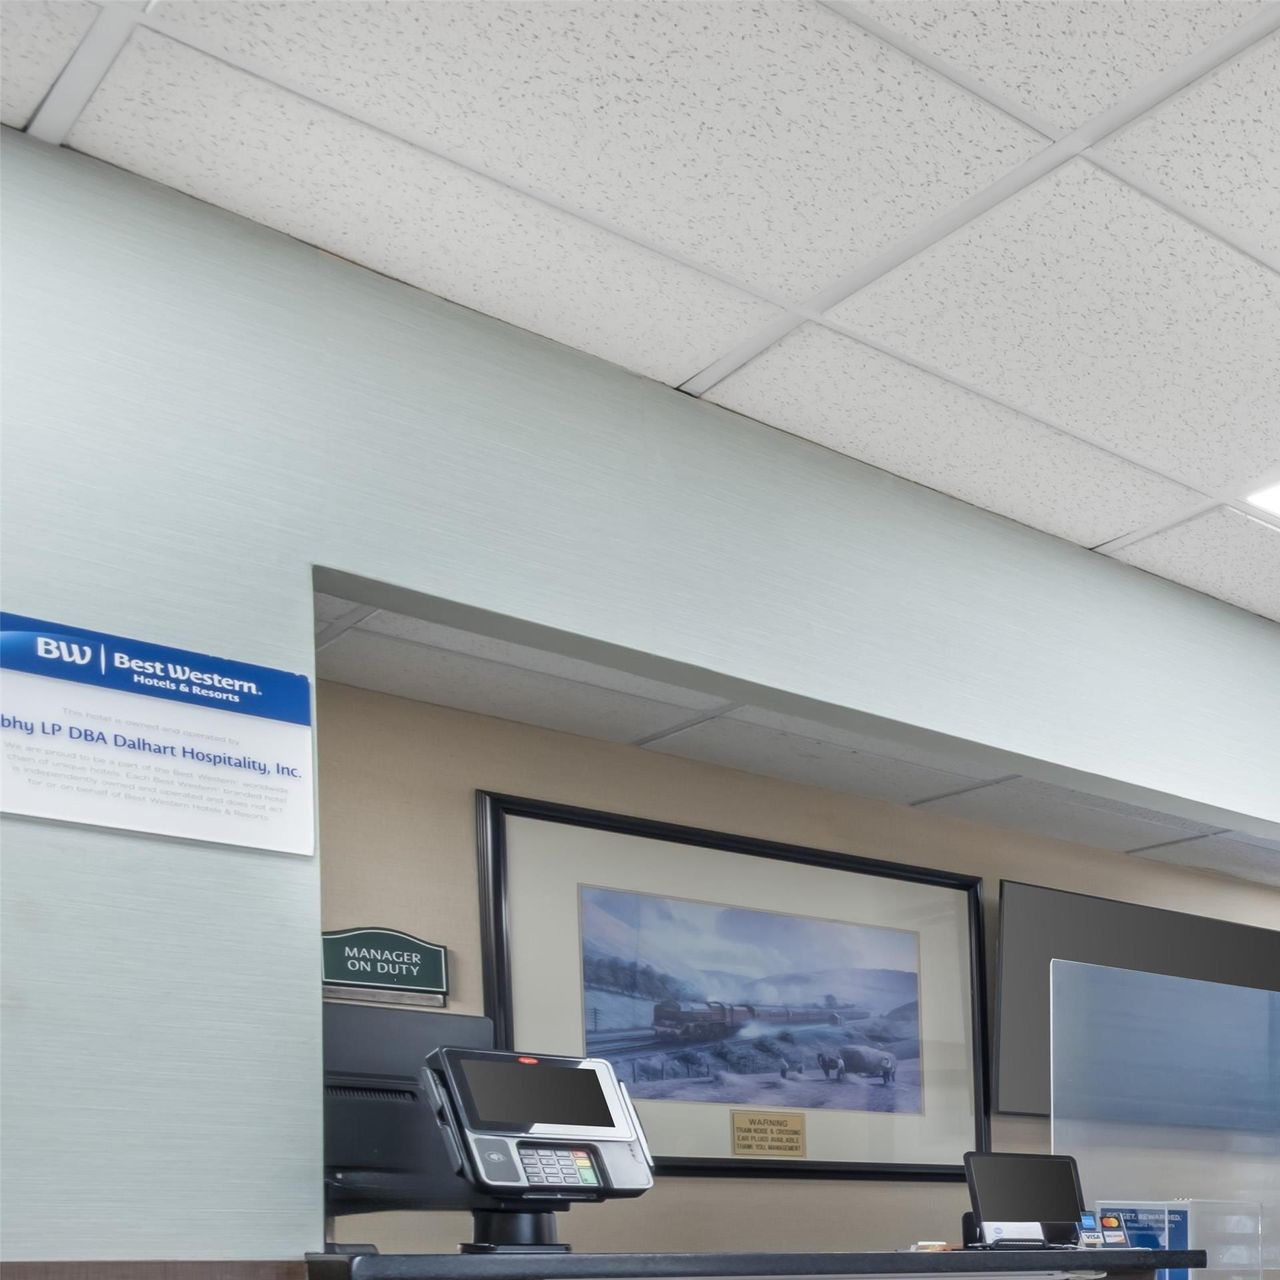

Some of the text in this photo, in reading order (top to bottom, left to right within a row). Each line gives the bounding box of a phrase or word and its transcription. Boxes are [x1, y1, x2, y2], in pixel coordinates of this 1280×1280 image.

[35, 635, 93, 666] BW
[113, 652, 164, 676] Best
[133, 673, 241, 703] Hotels & Resorts
[41, 721, 62, 735] LP
[68, 726, 108, 746] DBA
[113, 733, 177, 757] Dalhart
[182, 746, 271, 775] Hospitality,
[276, 762, 302, 778] Inc.
[345, 946, 421, 964] MANAGER
[347, 959, 420, 976] ON DUTY
[748, 1118, 788, 1127] WARNING
